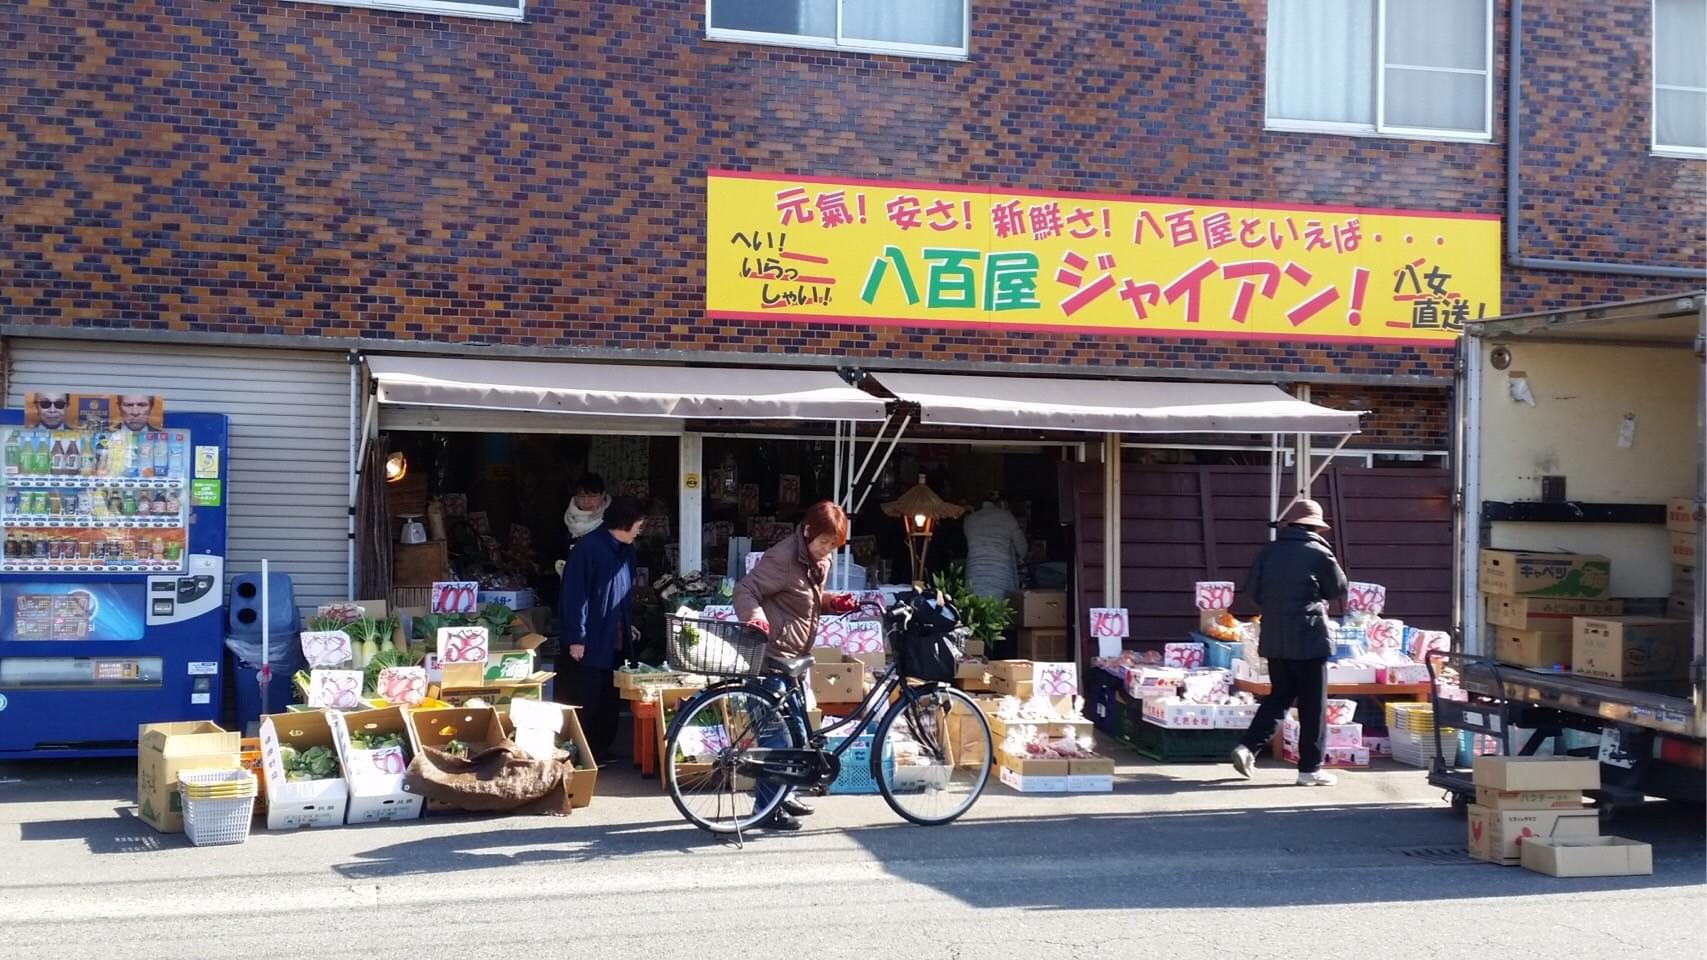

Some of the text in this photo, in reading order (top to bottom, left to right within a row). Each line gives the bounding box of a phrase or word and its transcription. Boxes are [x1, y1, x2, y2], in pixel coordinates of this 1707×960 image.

[775, 187, 868, 229] 元氣!
[886, 195, 973, 232] 安さ!
[991, 199, 1112, 241] 新鮮さ!
[730, 230, 787, 252] へい!
[740, 256, 799, 281] いらっ
[1393, 264, 1453, 295] 八女
[761, 284, 832, 307] しゃい!
[860, 245, 1371, 327] 八百屋 ジャイアン!
[1519, 565, 1567, 580] キャベツ
